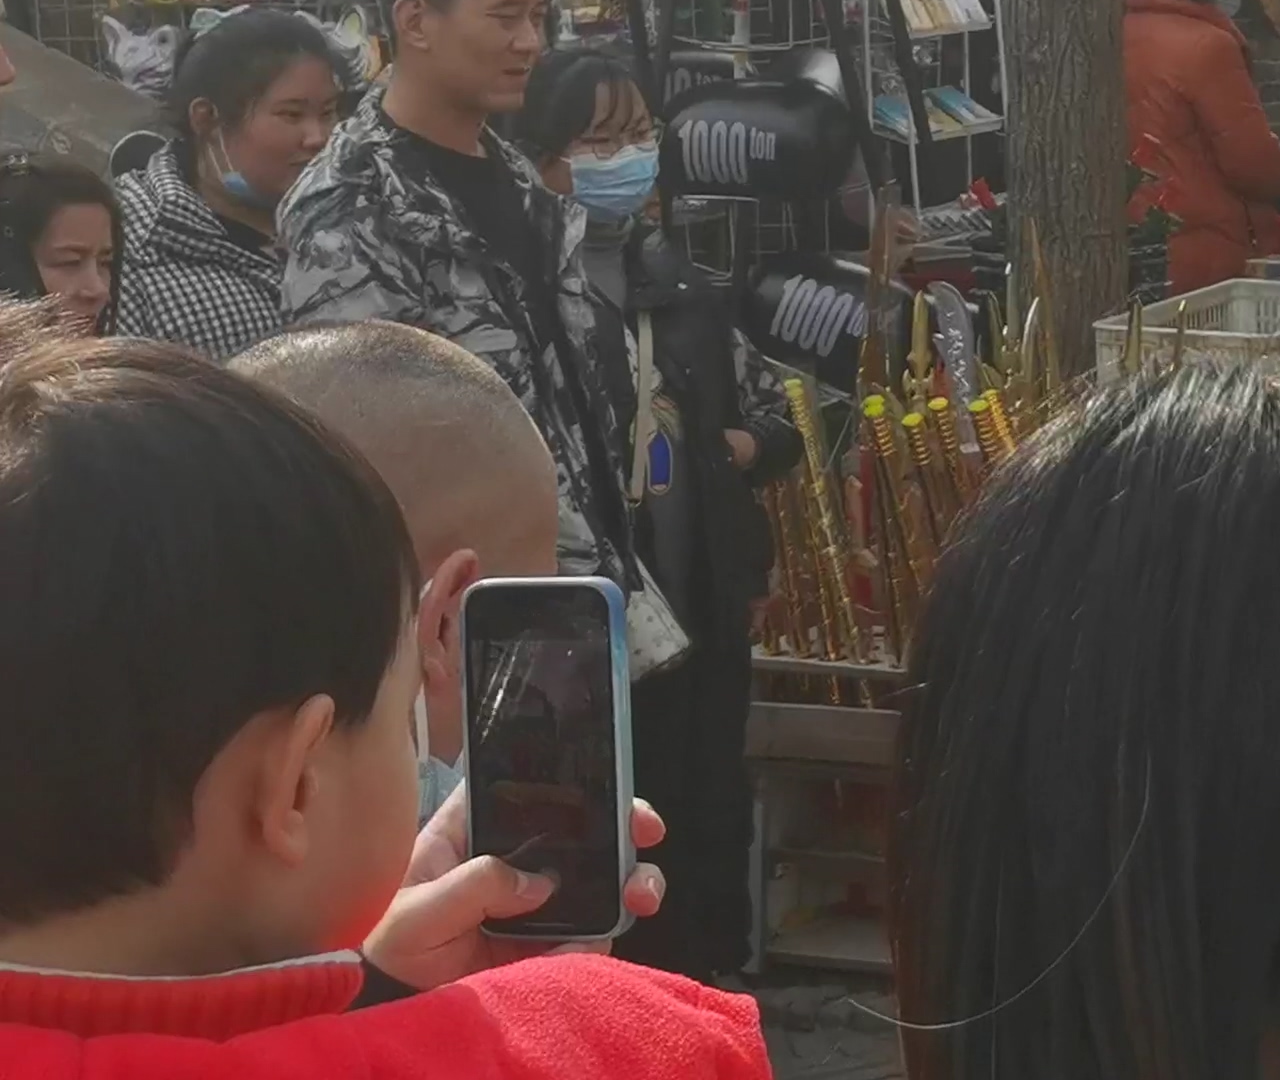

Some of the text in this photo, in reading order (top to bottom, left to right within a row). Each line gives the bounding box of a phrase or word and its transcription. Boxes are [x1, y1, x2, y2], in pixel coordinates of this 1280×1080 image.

[678, 119, 776, 184] 1000 ton
[769, 274, 855, 358] 1000
